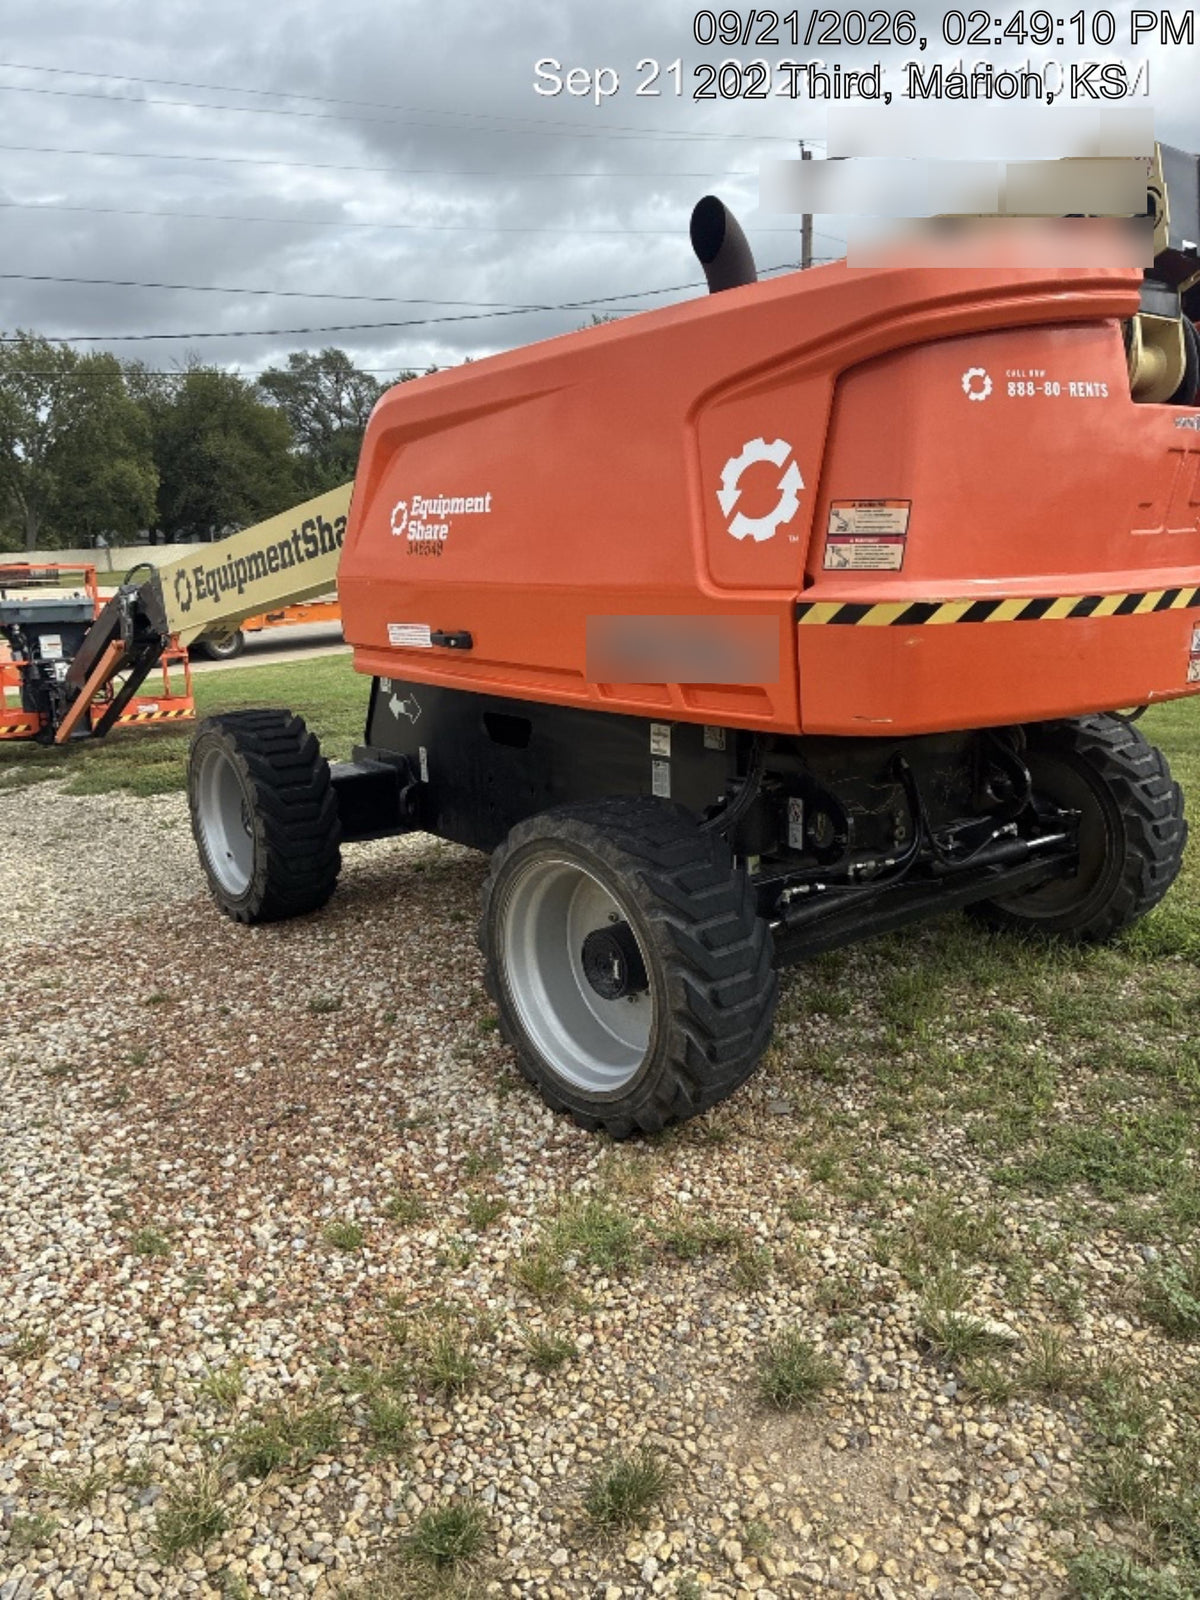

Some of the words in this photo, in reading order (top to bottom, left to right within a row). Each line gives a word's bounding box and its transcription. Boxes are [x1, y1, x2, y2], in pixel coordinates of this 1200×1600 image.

[1007, 381, 1109, 398] 888-80-RENTS
[410, 491, 492, 520] Equipment
[407, 520, 449, 541] Share
